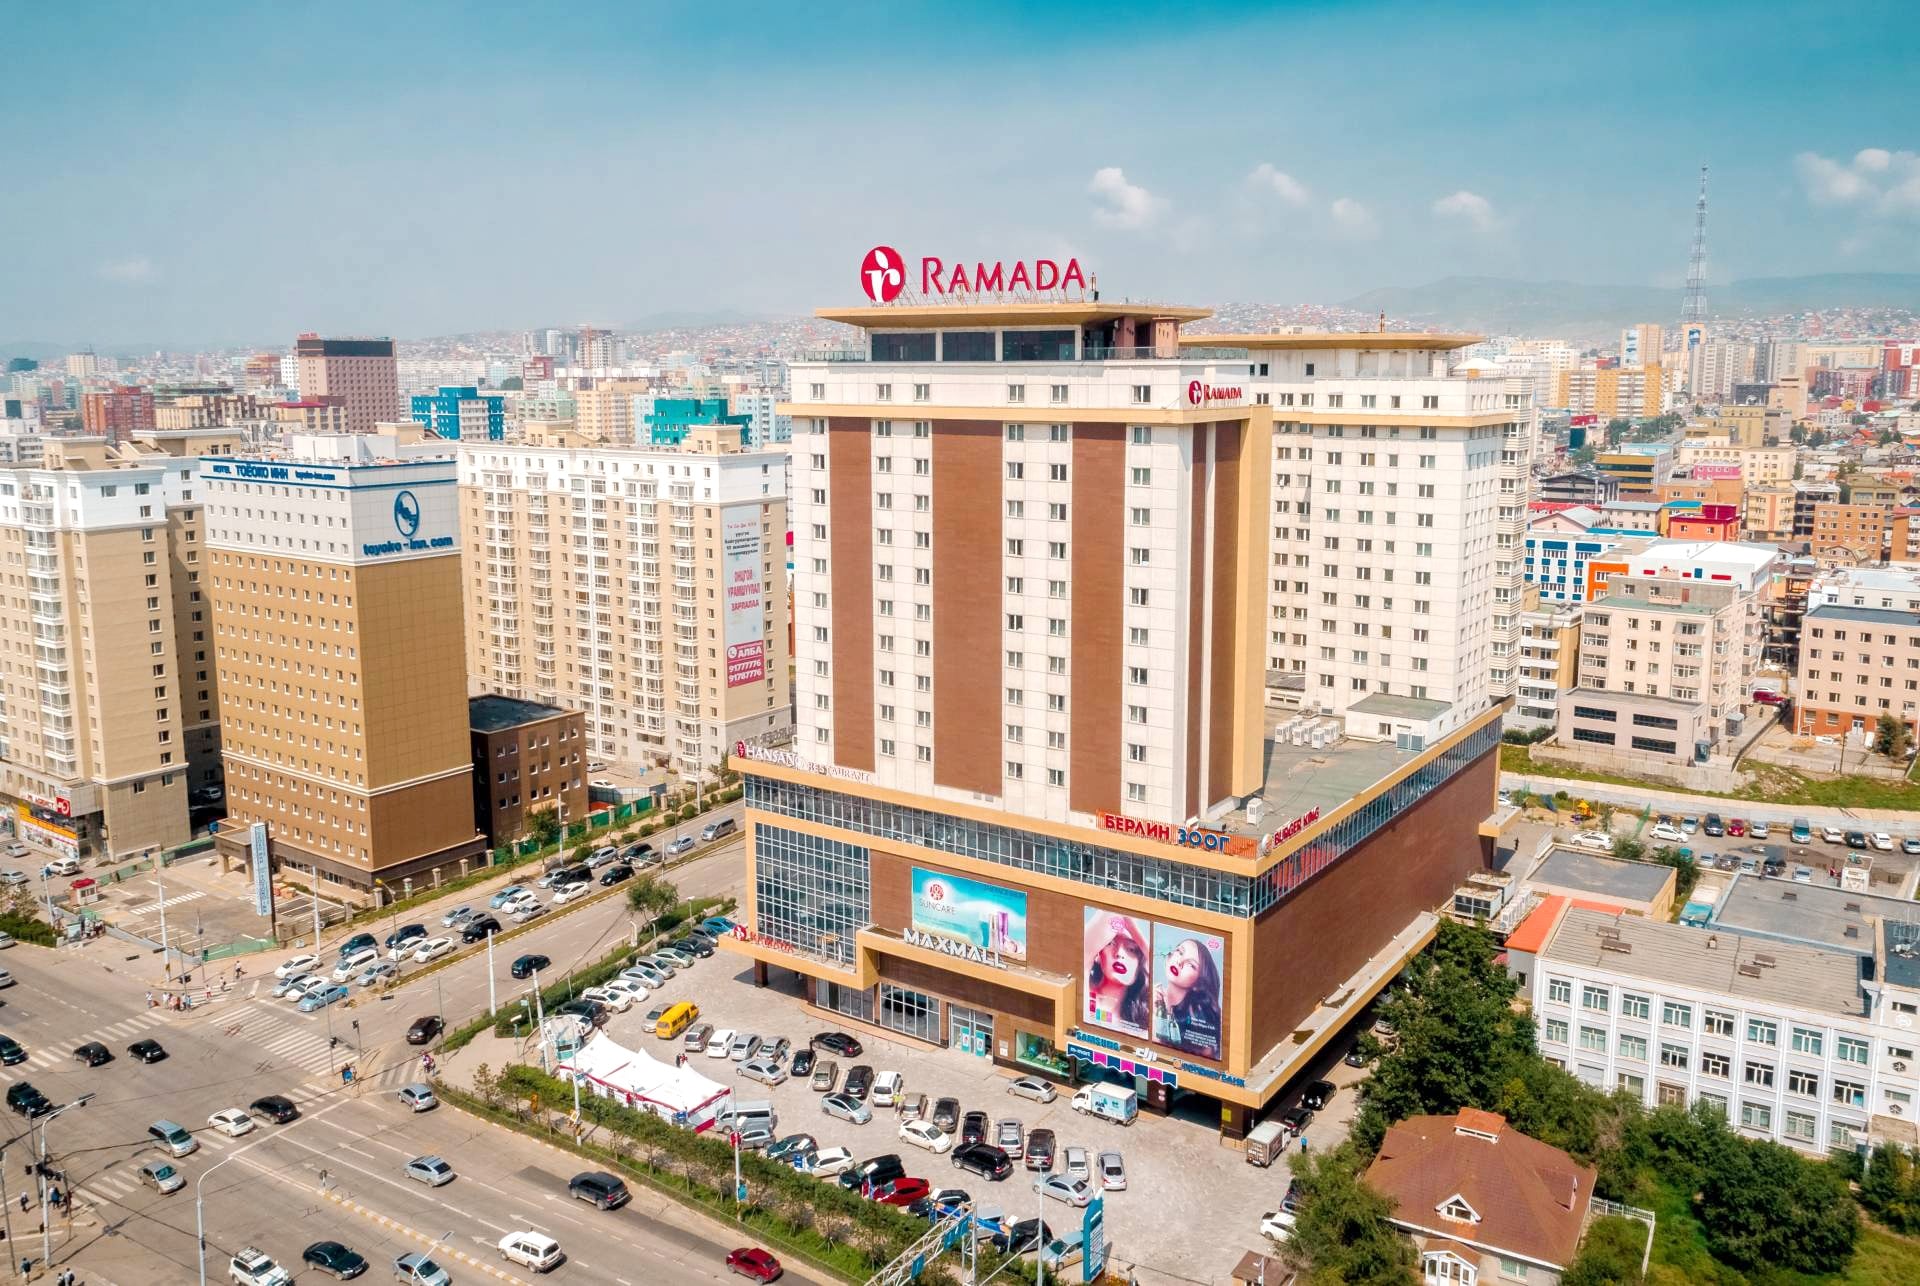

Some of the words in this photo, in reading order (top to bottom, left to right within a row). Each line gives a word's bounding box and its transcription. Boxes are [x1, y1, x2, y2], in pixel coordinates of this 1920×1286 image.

[1105, 815, 1170, 841] БЕРЛИН
[1274, 818, 1302, 846] BURGER
[1303, 806, 1320, 827] KING
[903, 927, 1008, 970] MAXMALL
[1076, 1031, 1120, 1051] SAMSUNG
